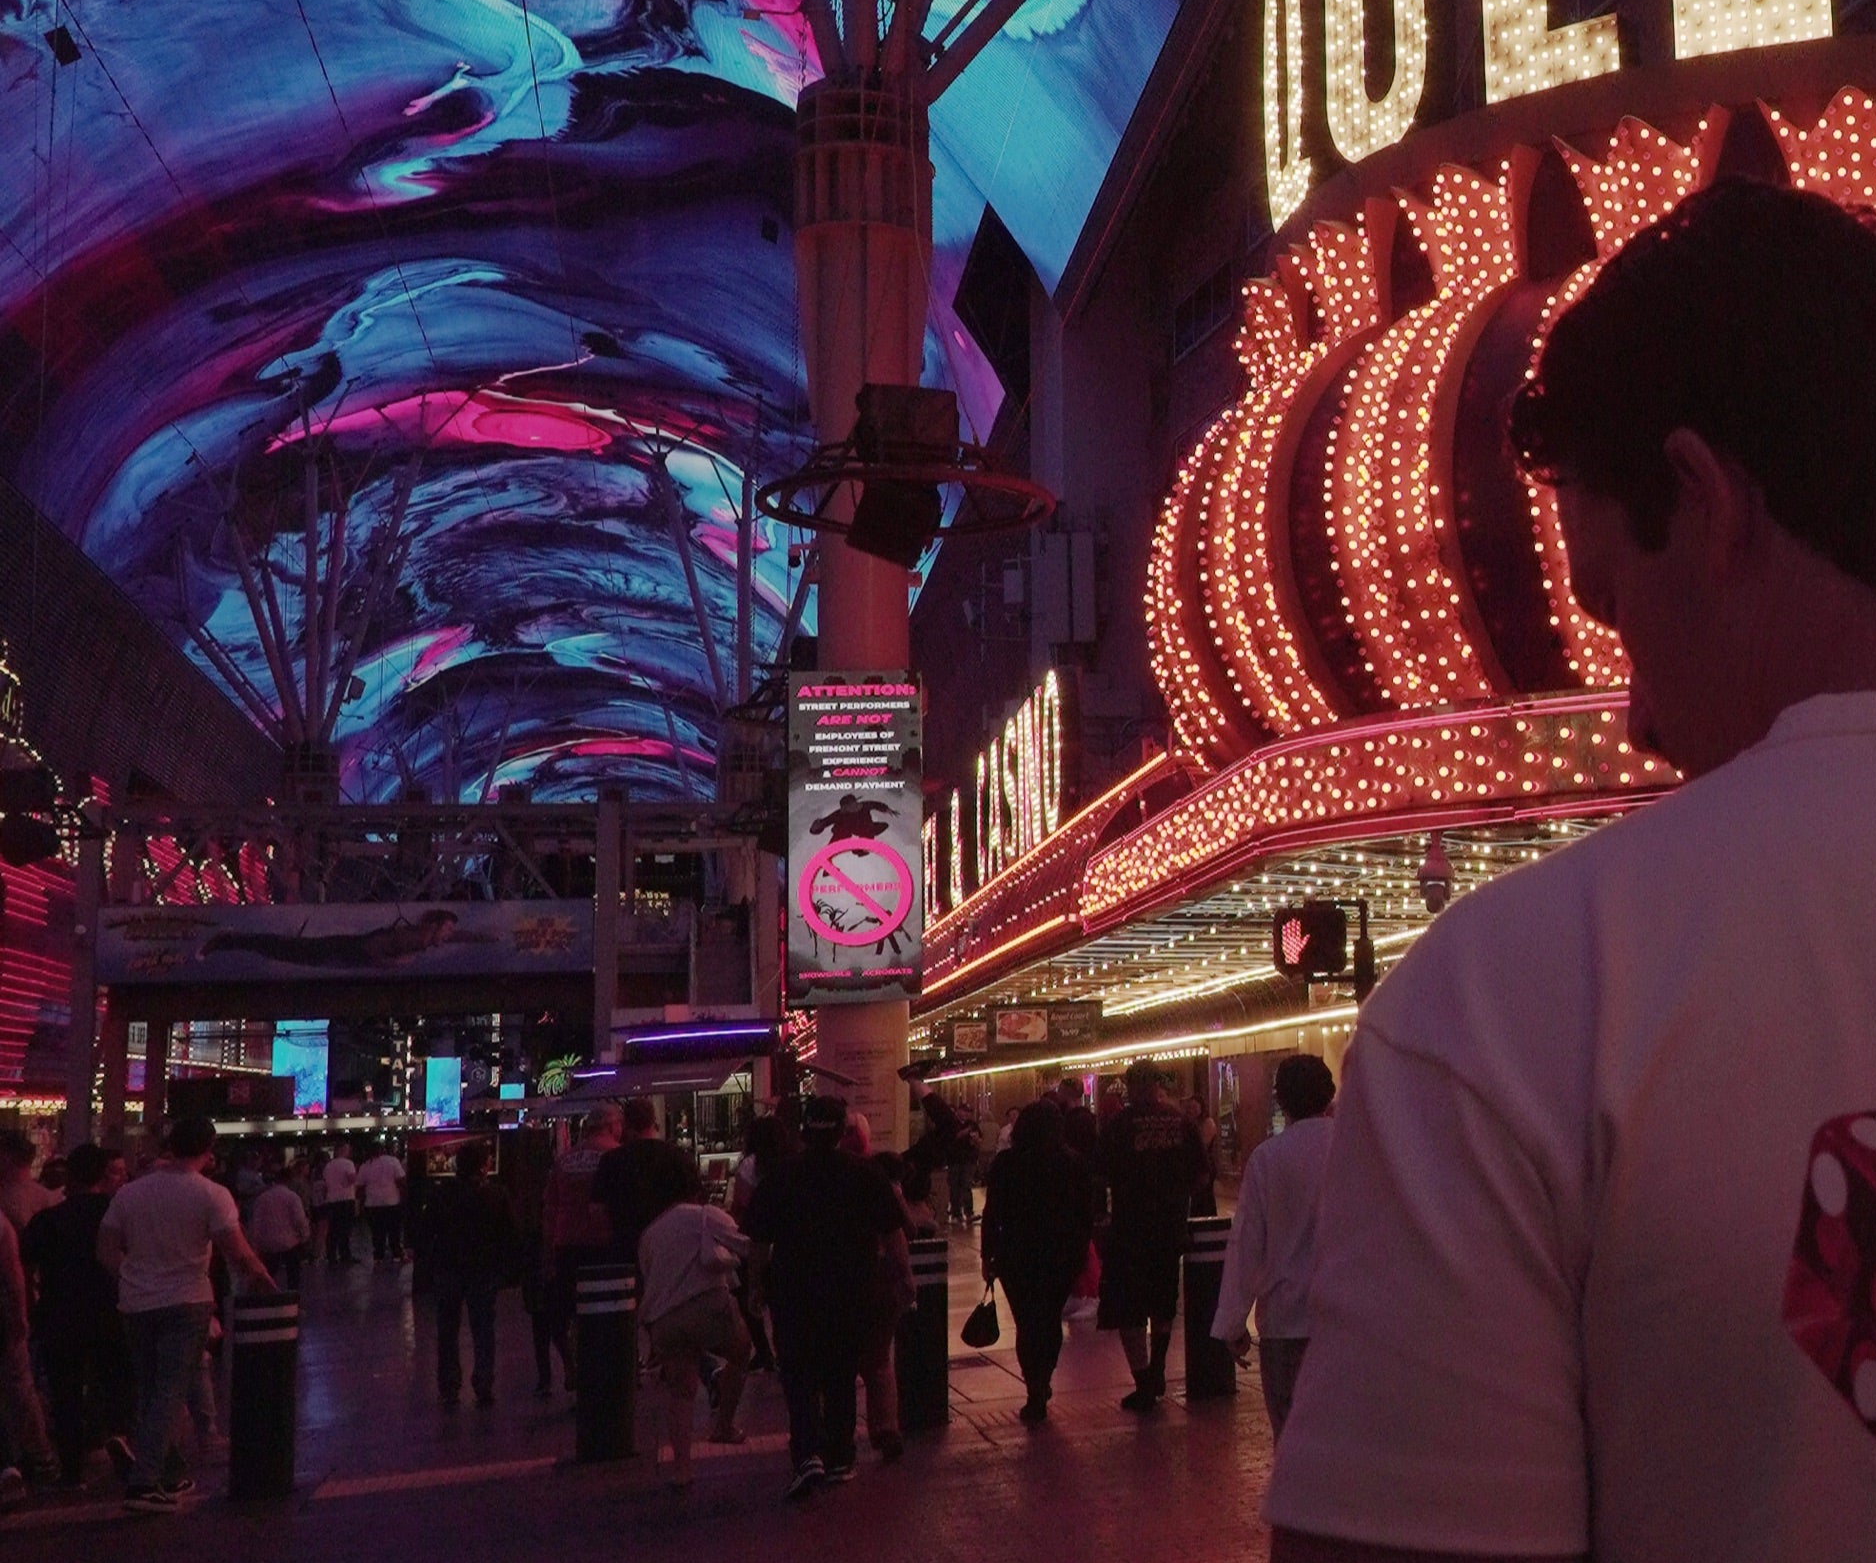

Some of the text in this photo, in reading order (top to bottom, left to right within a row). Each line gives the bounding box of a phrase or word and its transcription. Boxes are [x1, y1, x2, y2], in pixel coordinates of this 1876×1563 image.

[796, 683, 918, 698] ATTENTION:
[798, 700, 911, 711] STREET PERFORMERS
[815, 712, 895, 726] ARE NOT
[814, 730, 895, 741] EMPLOYEES OF
[808, 742, 902, 754] FREMONT STREET
[822, 756, 888, 765] EXPERIENCE
[832, 766, 890, 777] CANNOT
[975, 668, 1063, 887] CASINO
[804, 780, 906, 792] DEMAND PAYMENT
